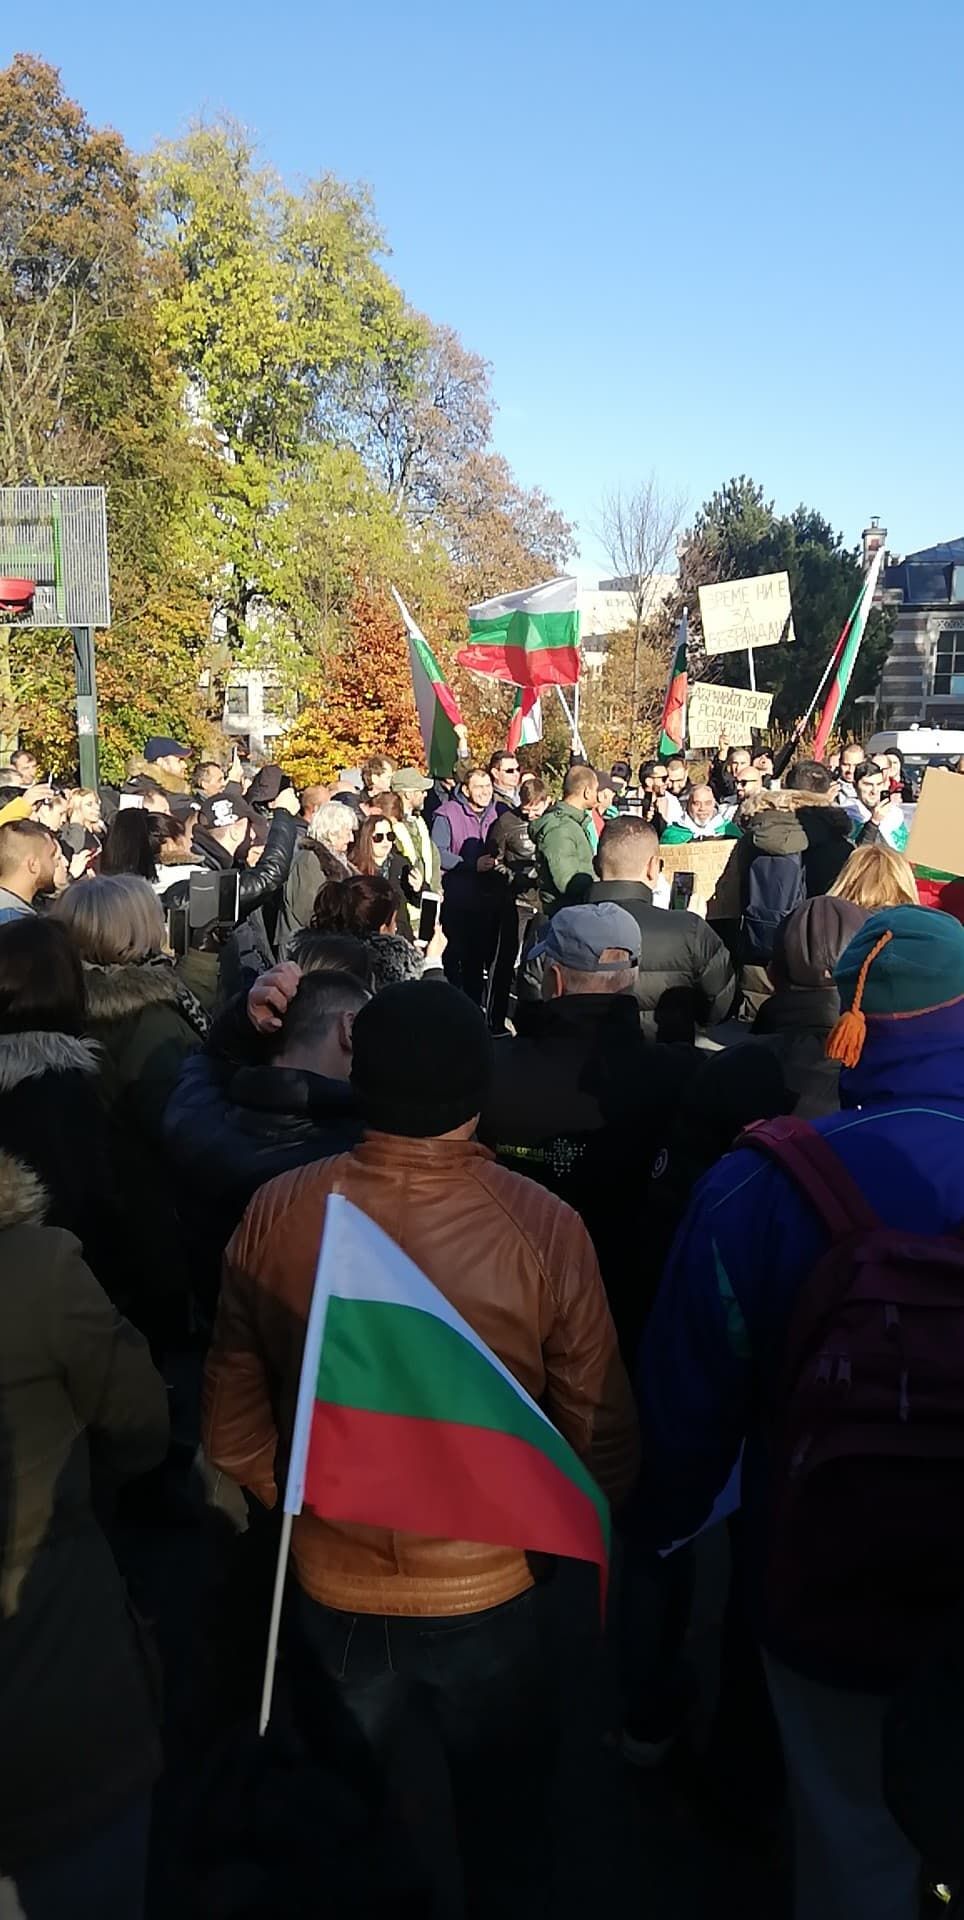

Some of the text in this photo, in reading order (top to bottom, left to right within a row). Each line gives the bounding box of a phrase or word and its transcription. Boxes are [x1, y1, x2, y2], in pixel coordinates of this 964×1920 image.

[756, 581, 774, 600] НИ
[778, 579, 788, 598] Е
[730, 607, 753, 627] ЗА
[698, 703, 758, 725] РОДИНАТА
